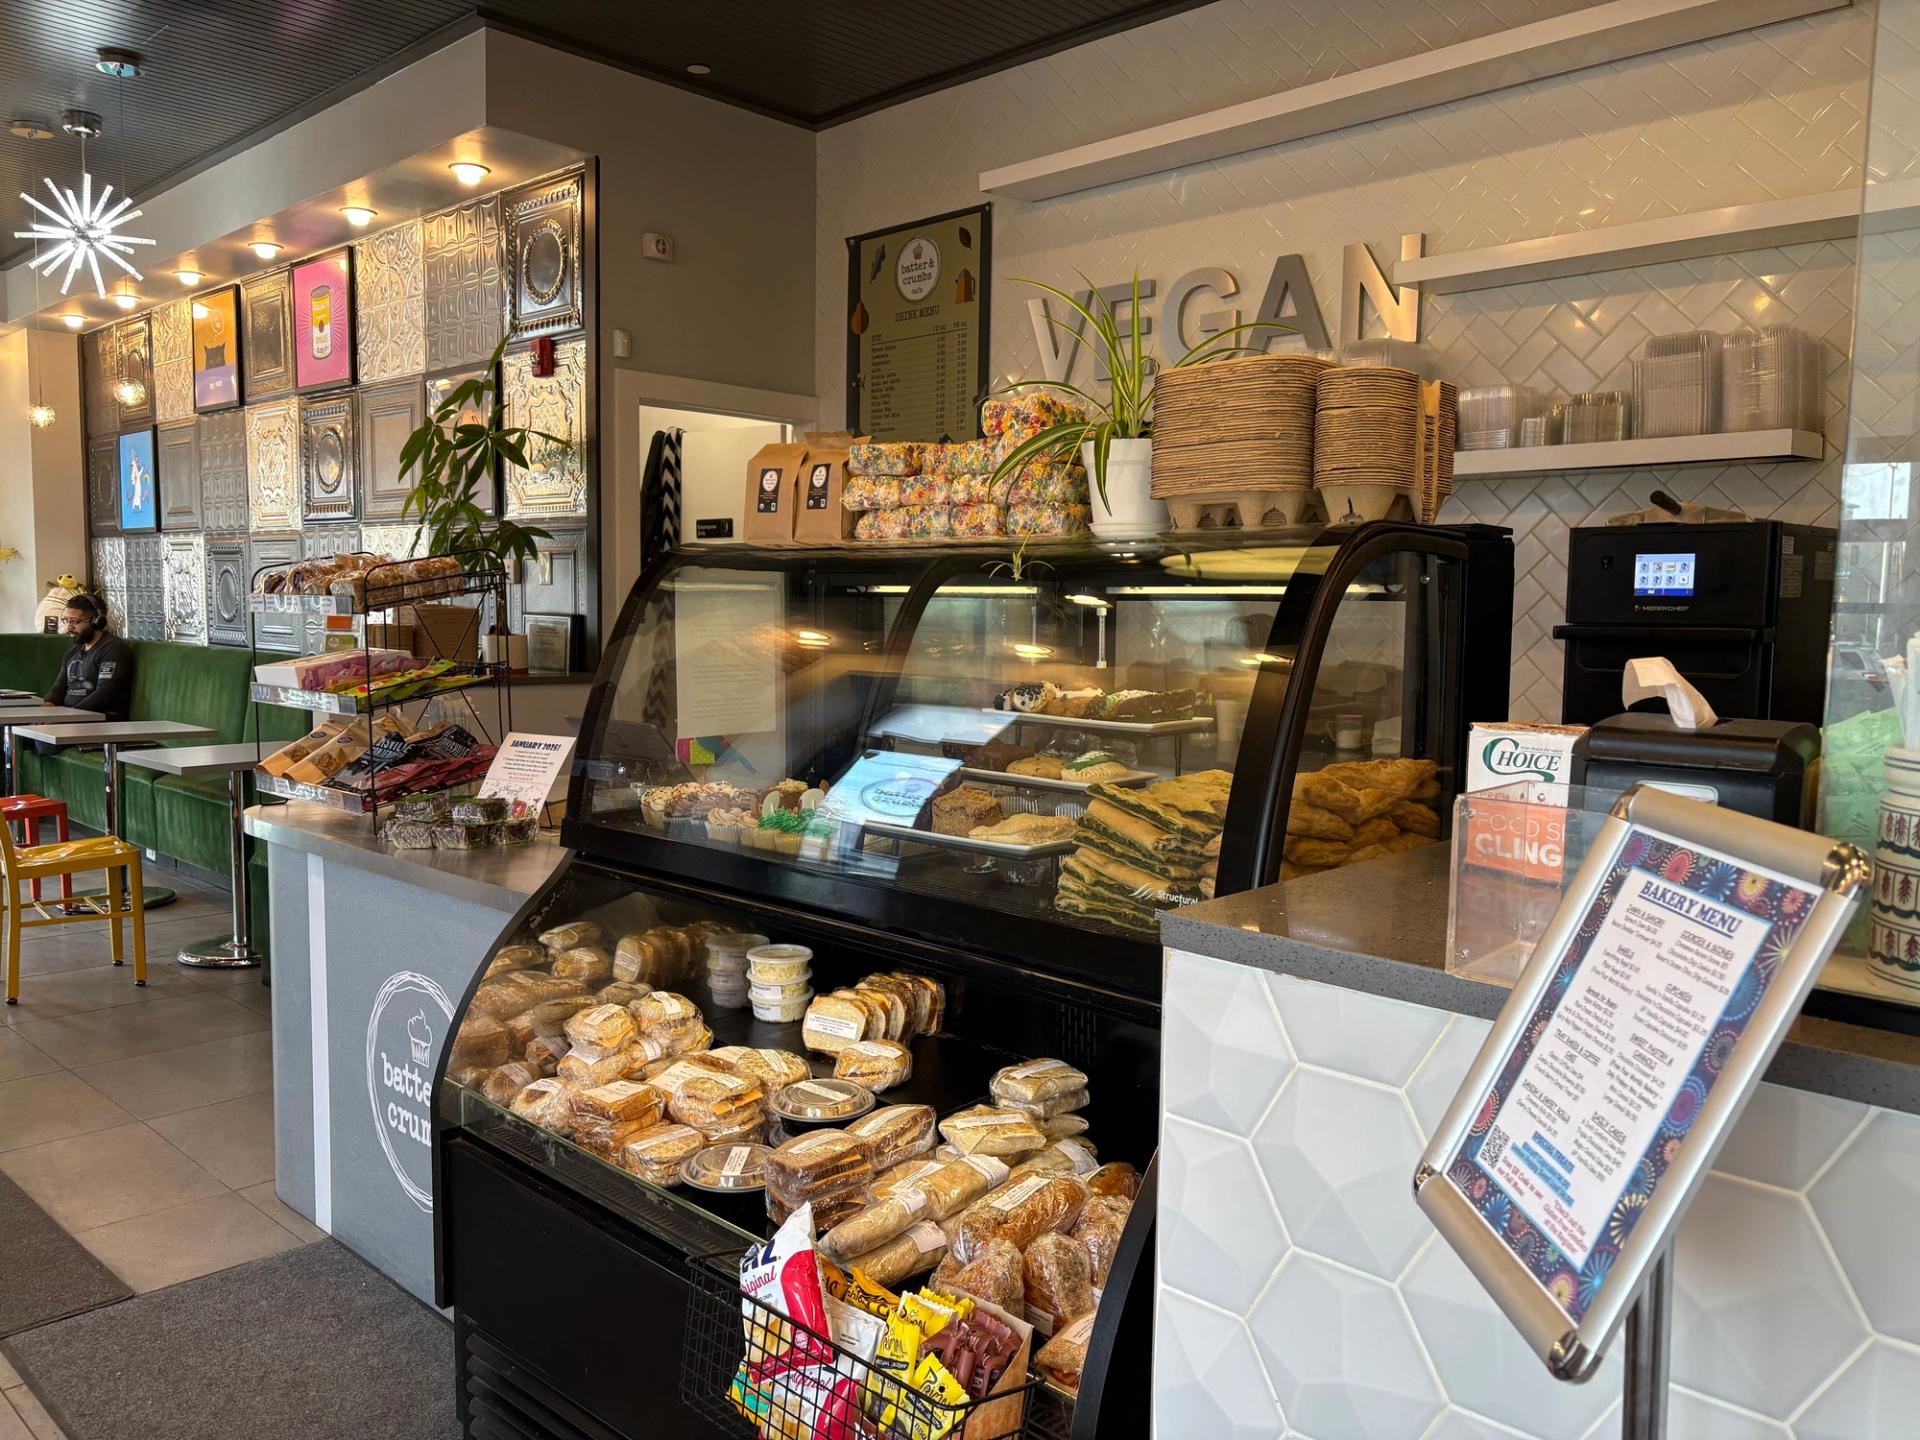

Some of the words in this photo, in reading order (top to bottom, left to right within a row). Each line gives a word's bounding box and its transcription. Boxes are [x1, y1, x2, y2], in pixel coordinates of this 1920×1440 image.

[901, 261, 927, 274] batter
[902, 272, 933, 285] crumbs
[919, 305, 940, 318] MENU
[1027, 232, 1425, 385] VEGAN
[511, 740, 543, 749] JANUARY
[1483, 737, 1562, 779] CHOICE
[1478, 811, 1540, 838] FOOD
[1474, 832, 1562, 868] CLING
[1157, 890, 1199, 905] Structural
[1640, 880, 1699, 916] BAKERY
[1695, 904, 1742, 935] MENU
[381, 1052, 431, 1107] batte
[740, 1265, 777, 1298] riginal
